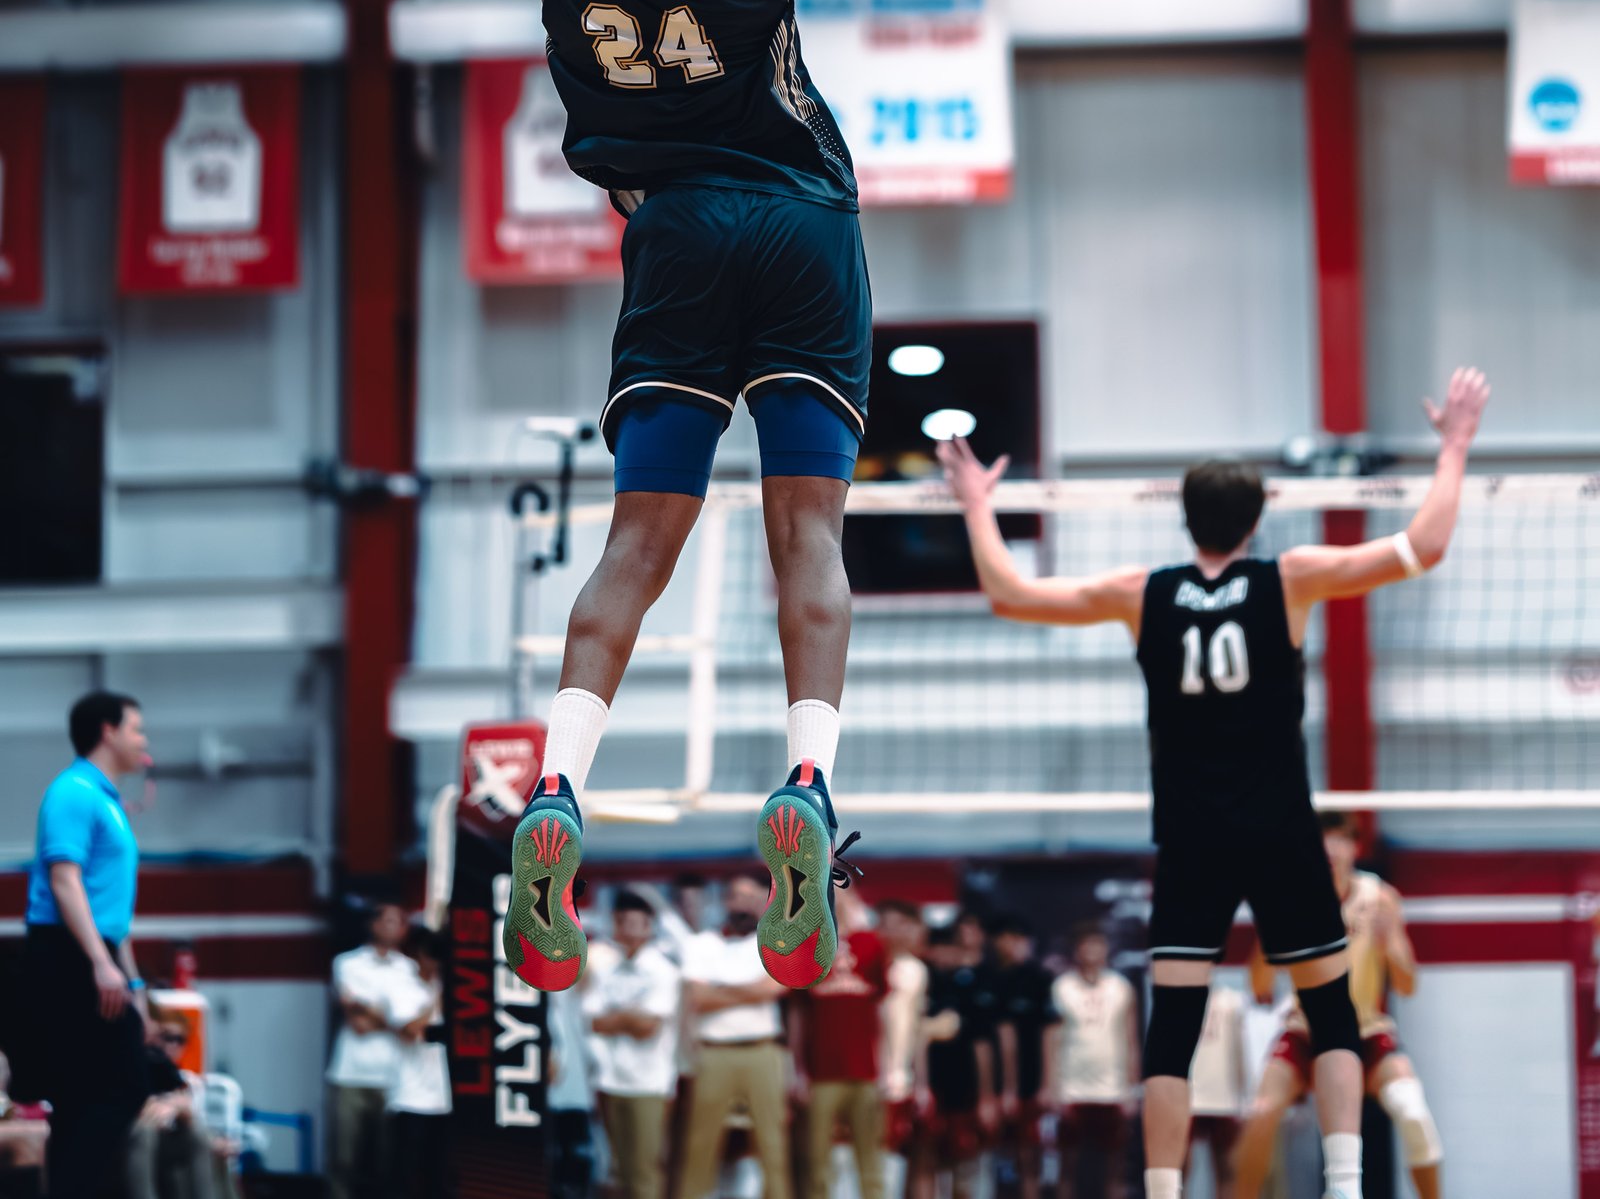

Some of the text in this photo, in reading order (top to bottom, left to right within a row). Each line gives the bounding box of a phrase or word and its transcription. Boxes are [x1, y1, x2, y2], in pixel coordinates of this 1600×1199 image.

[581, 2, 725, 88] 24
[1180, 619, 1251, 694] 10
[453, 907, 491, 1095] LEWIS
